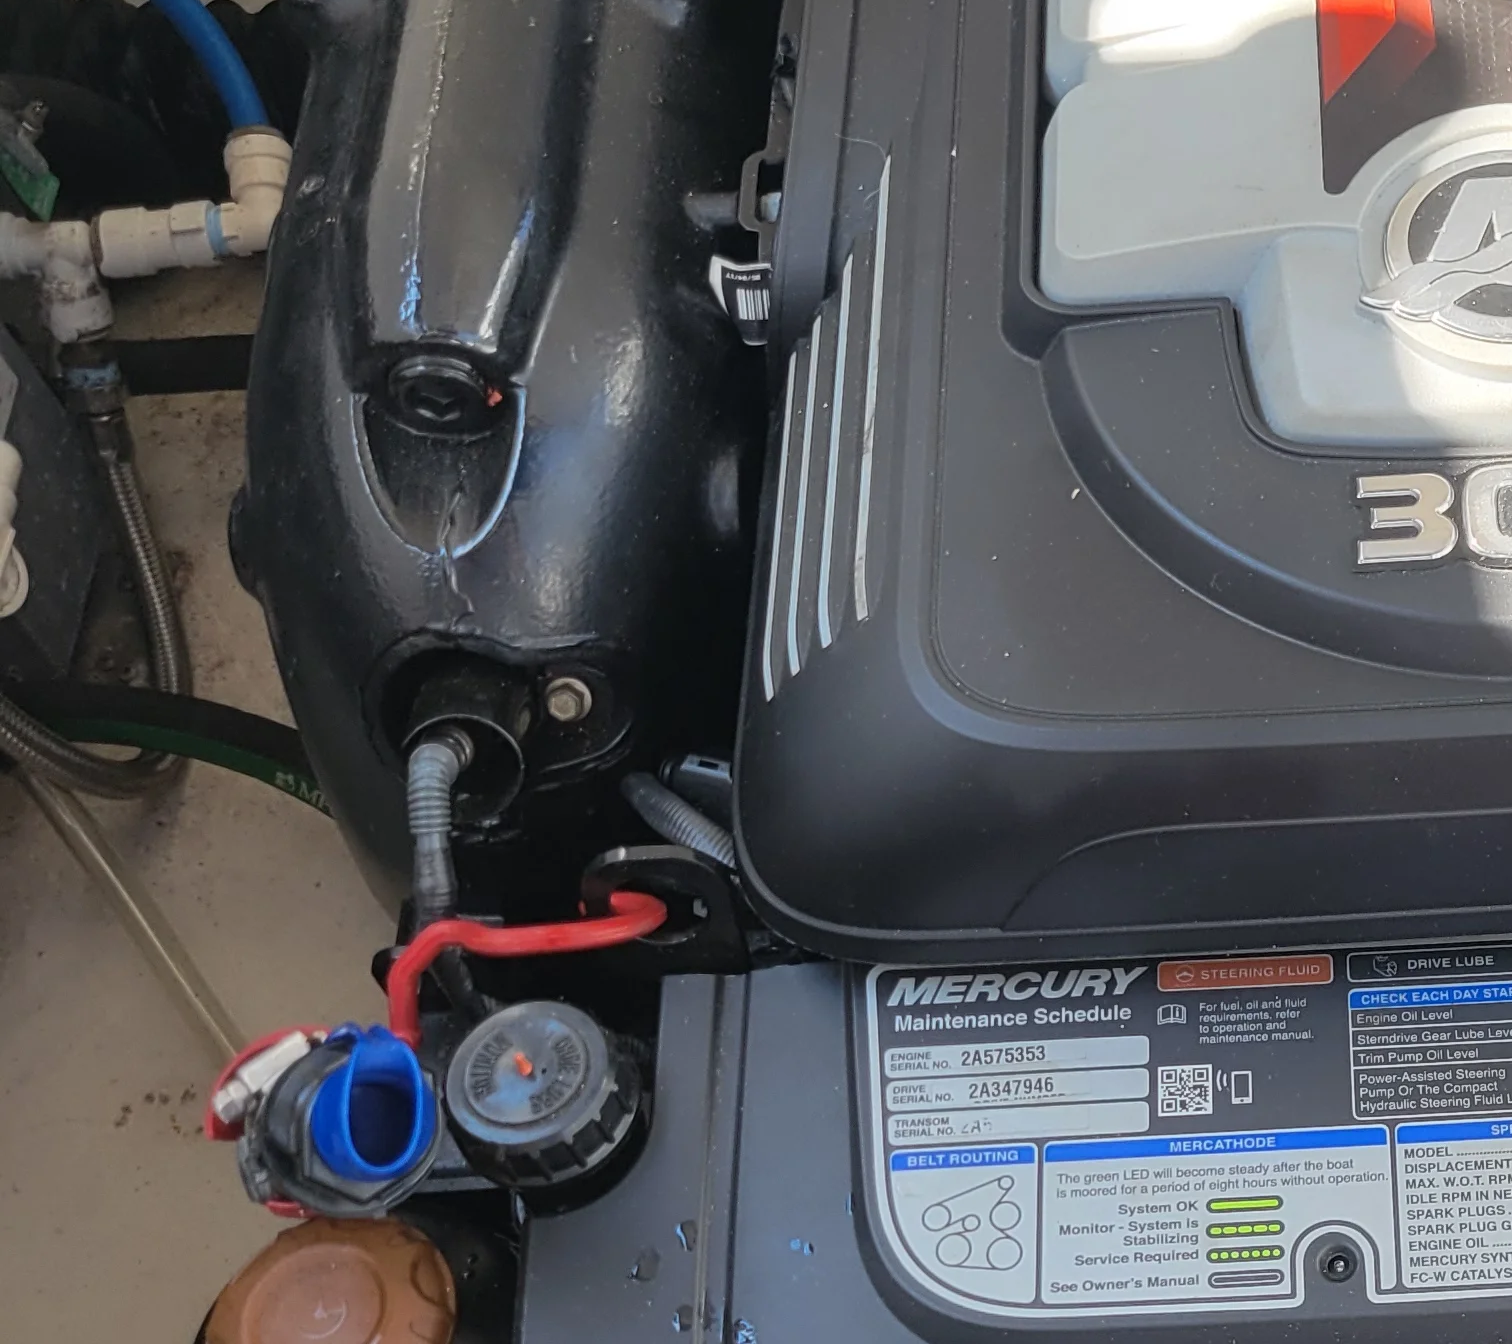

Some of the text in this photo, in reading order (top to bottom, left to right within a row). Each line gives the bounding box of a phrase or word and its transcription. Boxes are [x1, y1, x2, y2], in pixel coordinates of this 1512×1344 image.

[1407, 955, 1494, 969] DRIVE LUBE
[1201, 964, 1320, 979] STEERING FLUID
[887, 968, 1150, 1005] MERCURY
[1361, 992, 1408, 1004] CHECK
[1411, 990, 1449, 1002] EACH
[1453, 988, 1479, 999] DAY
[894, 1005, 1131, 1031] Maintenance Schedule
[1356, 1009, 1453, 1025] Engine Oil Level
[1357, 1033, 1417, 1044] Sterndrive
[1421, 1031, 1451, 1041] Gear
[1454, 1029, 1484, 1039] Lube
[890, 1051, 930, 1061] ENGINE
[961, 1045, 1045, 1066] 2A575353
[1357, 1048, 1478, 1065] Trim Pump Oil Level
[890, 1060, 951, 1071] SERIAL NO.
[1359, 1068, 1505, 1084] Power-Assisted Steering
[892, 1084, 925, 1094] DRIVE
[969, 1077, 1054, 1098] 2A347946
[1359, 1081, 1498, 1098] Pump Or The Compact
[892, 1092, 953, 1104] SERIAL NO.
[1360, 1099, 1416, 1113] Hydraulic
[1420, 1097, 1470, 1108] Steering
[1474, 1094, 1503, 1105] Fluid
[894, 1117, 949, 1127] TRANSOM
[894, 1126, 955, 1138] SERIAL NO.
[1169, 1136, 1275, 1151] MERCATHODE
[907, 1150, 1018, 1166] BELT ROUTING
[1404, 1146, 1453, 1158] MODEL
[1404, 1158, 1512, 1173] DISPLACEMENT
[1405, 1177, 1439, 1189] MAX.
[1443, 1175, 1484, 1187] W.O.T.
[1406, 1193, 1437, 1204] IDLE
[1441, 1191, 1471, 1202] RPM
[1475, 1190, 1489, 1200] IN
[1118, 1200, 1198, 1216] System OK
[1406, 1207, 1454, 1220] SPARK
[1458, 1204, 1505, 1217] PLUGS
[1059, 1223, 1114, 1235] Monitor
[1128, 1220, 1181, 1233] System
[1186, 1217, 1199, 1228] is
[1407, 1223, 1455, 1235] SPARK
[1459, 1221, 1497, 1232] PLUG
[1123, 1233, 1198, 1246] Stabilizing
[1408, 1238, 1461, 1251] ENGINE
[1465, 1237, 1489, 1248] OIL
[1074, 1249, 1199, 1266] Service Required
[1409, 1253, 1477, 1267] MERCURY
[1050, 1274, 1199, 1293] See Owner's Manual
[1410, 1271, 1446, 1283] FC-W
